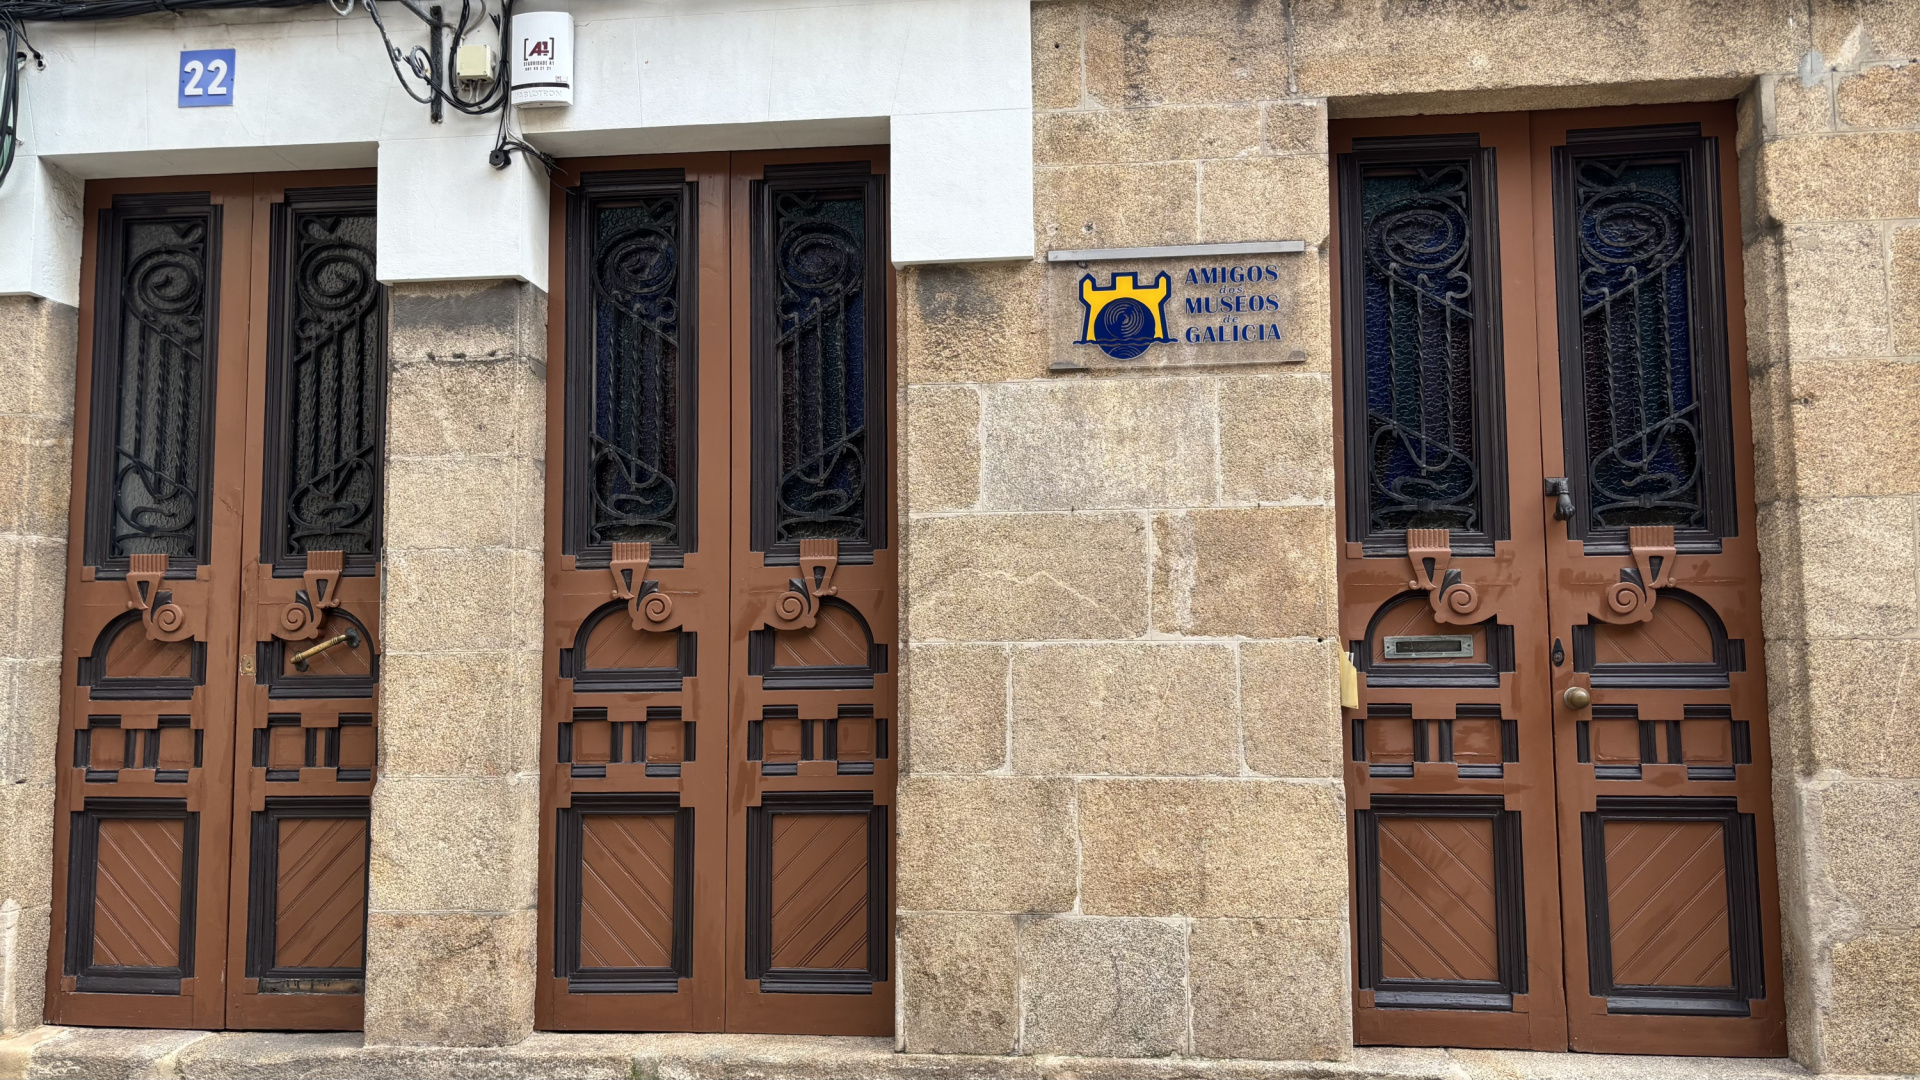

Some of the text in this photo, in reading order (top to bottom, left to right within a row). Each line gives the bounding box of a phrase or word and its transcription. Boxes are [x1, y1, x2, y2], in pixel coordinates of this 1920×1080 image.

[184, 59, 228, 97] 22
[1185, 265, 1279, 285] AMIGOS
[1219, 286, 1244, 294] dos
[1185, 295, 1279, 314] MUSEOS
[1223, 315, 1239, 324] de
[1185, 324, 1281, 343] GALICIA
